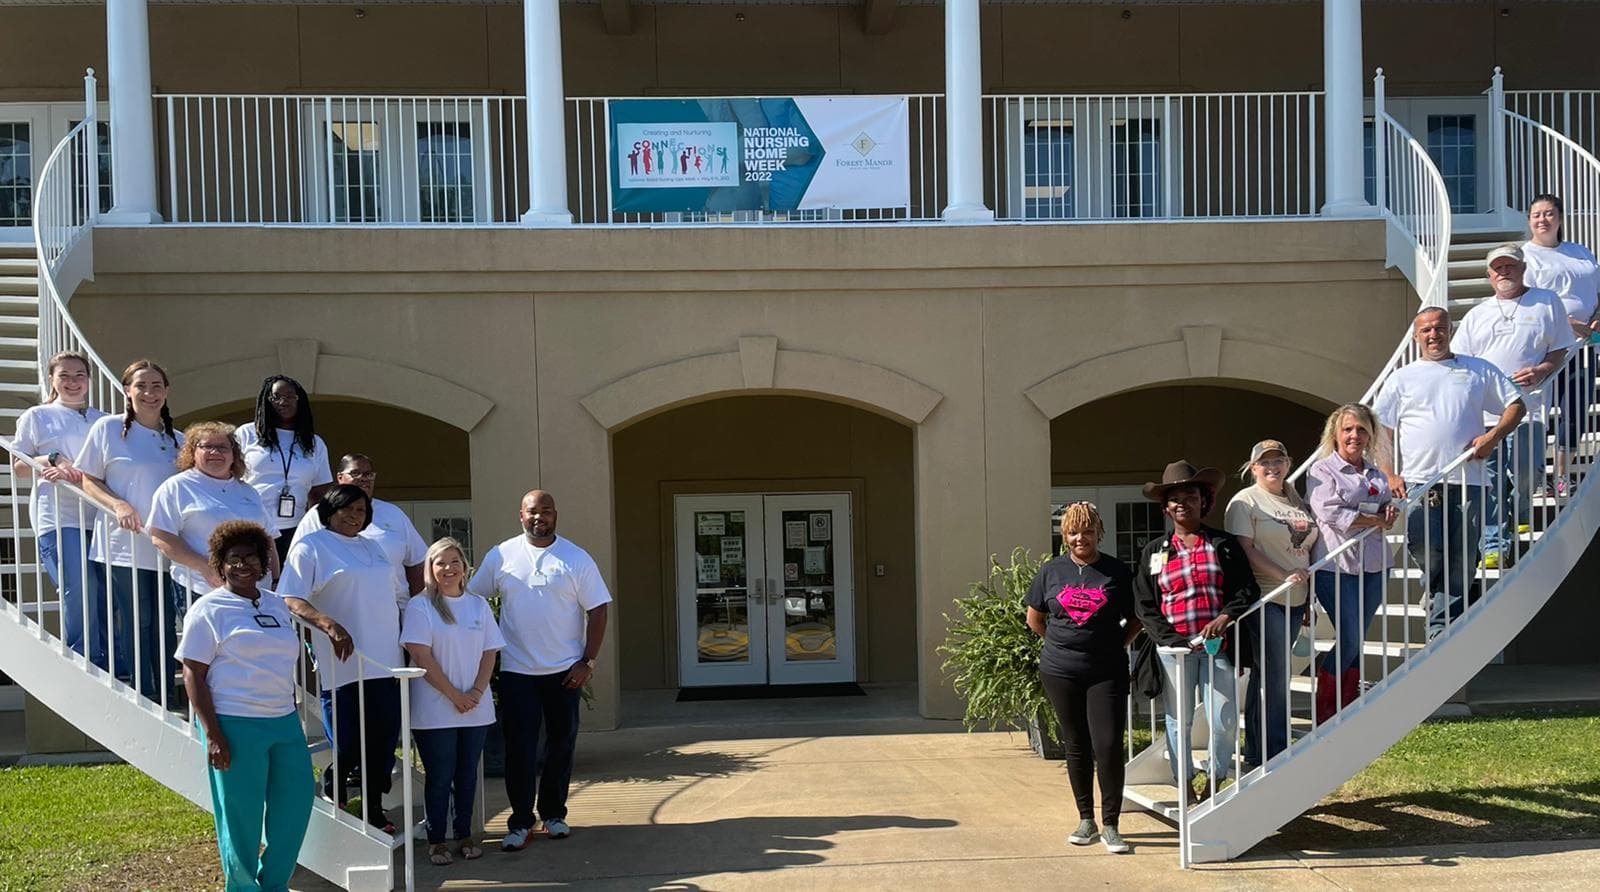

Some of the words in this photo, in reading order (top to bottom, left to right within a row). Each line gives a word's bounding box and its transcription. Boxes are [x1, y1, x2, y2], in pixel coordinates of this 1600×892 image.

[642, 129, 668, 137] Creating
[683, 129, 712, 137] Nurturing
[743, 127, 800, 137] NATIONAL
[634, 138, 724, 156] CONNECTIONS
[744, 136, 809, 148] NURSING
[744, 148, 787, 159] HOME
[744, 159, 787, 171] WEEK
[835, 159, 863, 167] FOREST
[865, 158, 893, 167] MANOR
[745, 171, 773, 182] 2022
